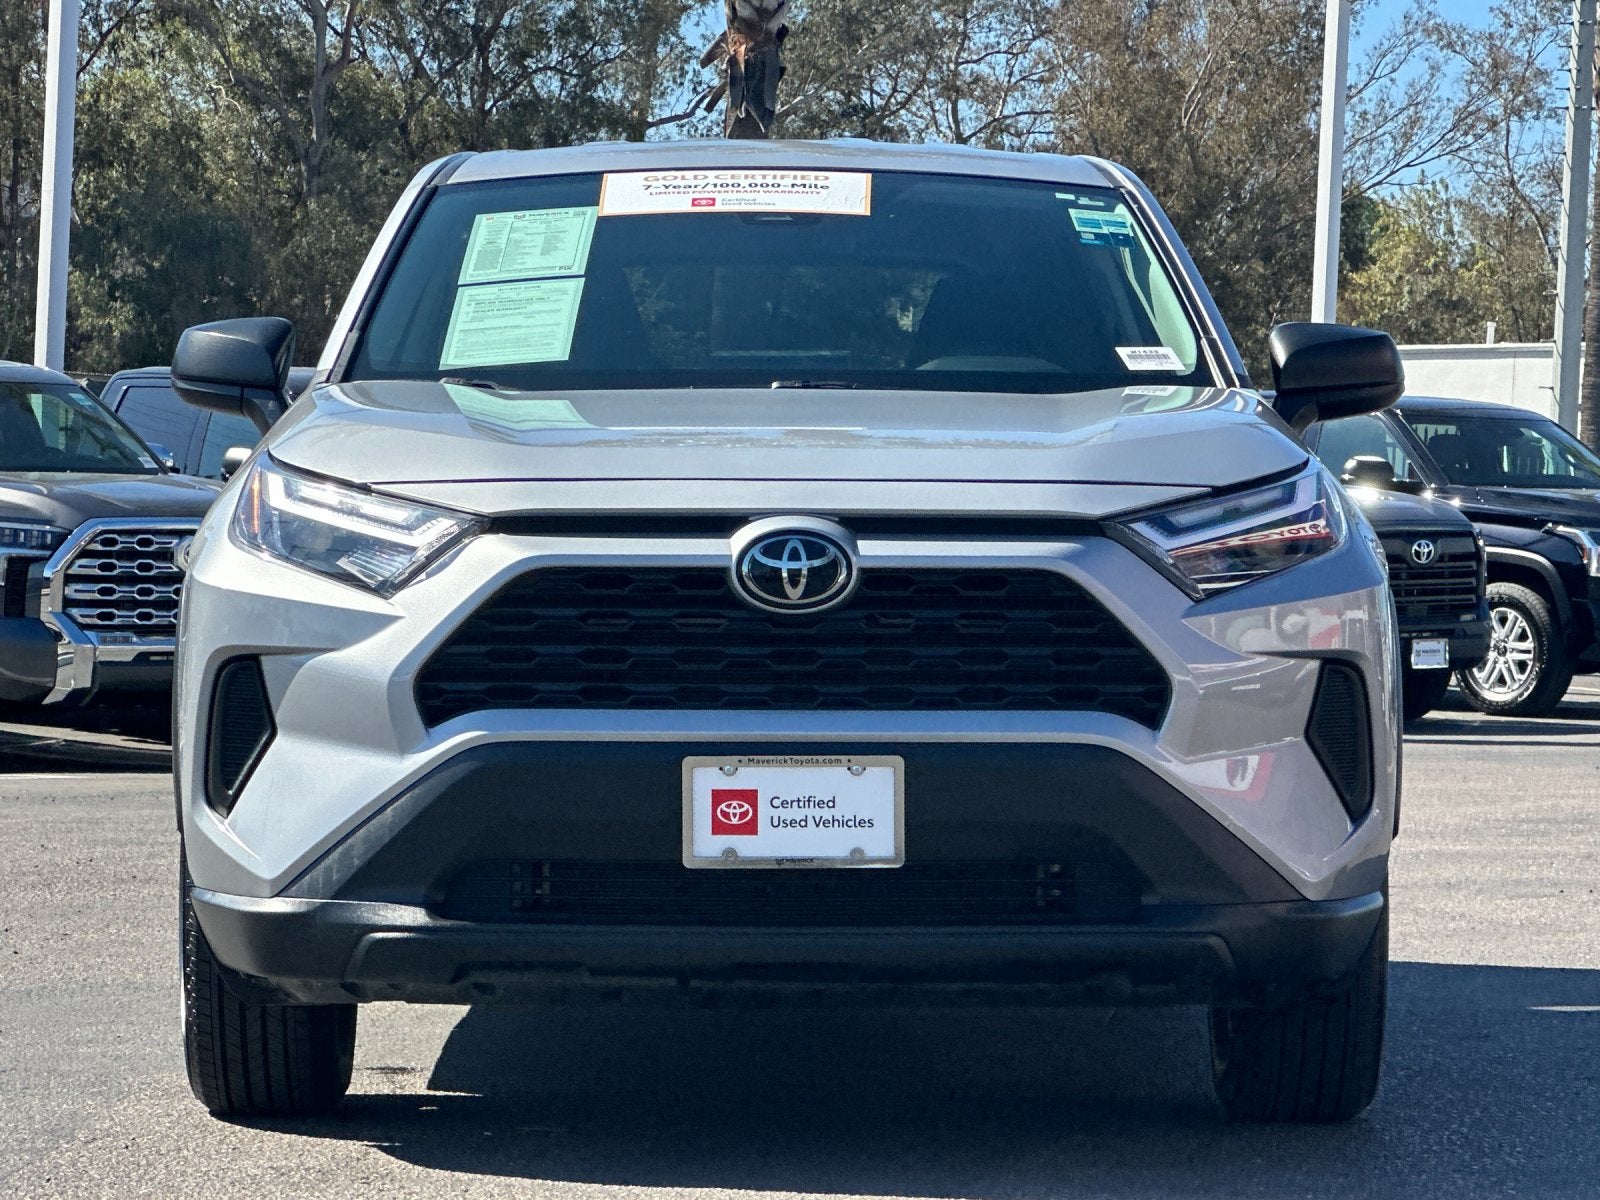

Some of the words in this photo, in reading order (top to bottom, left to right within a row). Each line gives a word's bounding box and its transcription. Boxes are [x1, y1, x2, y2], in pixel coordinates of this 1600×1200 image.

[643, 174, 709, 182] GOLD
[714, 173, 830, 181] CERTIFIED
[642, 182, 830, 190] 7-Year/100,000-Mile
[747, 757, 842, 766] MaverickToyota.com
[770, 796, 836, 809] Certified
[770, 815, 808, 828] Used
[812, 815, 875, 828] Vehicles
